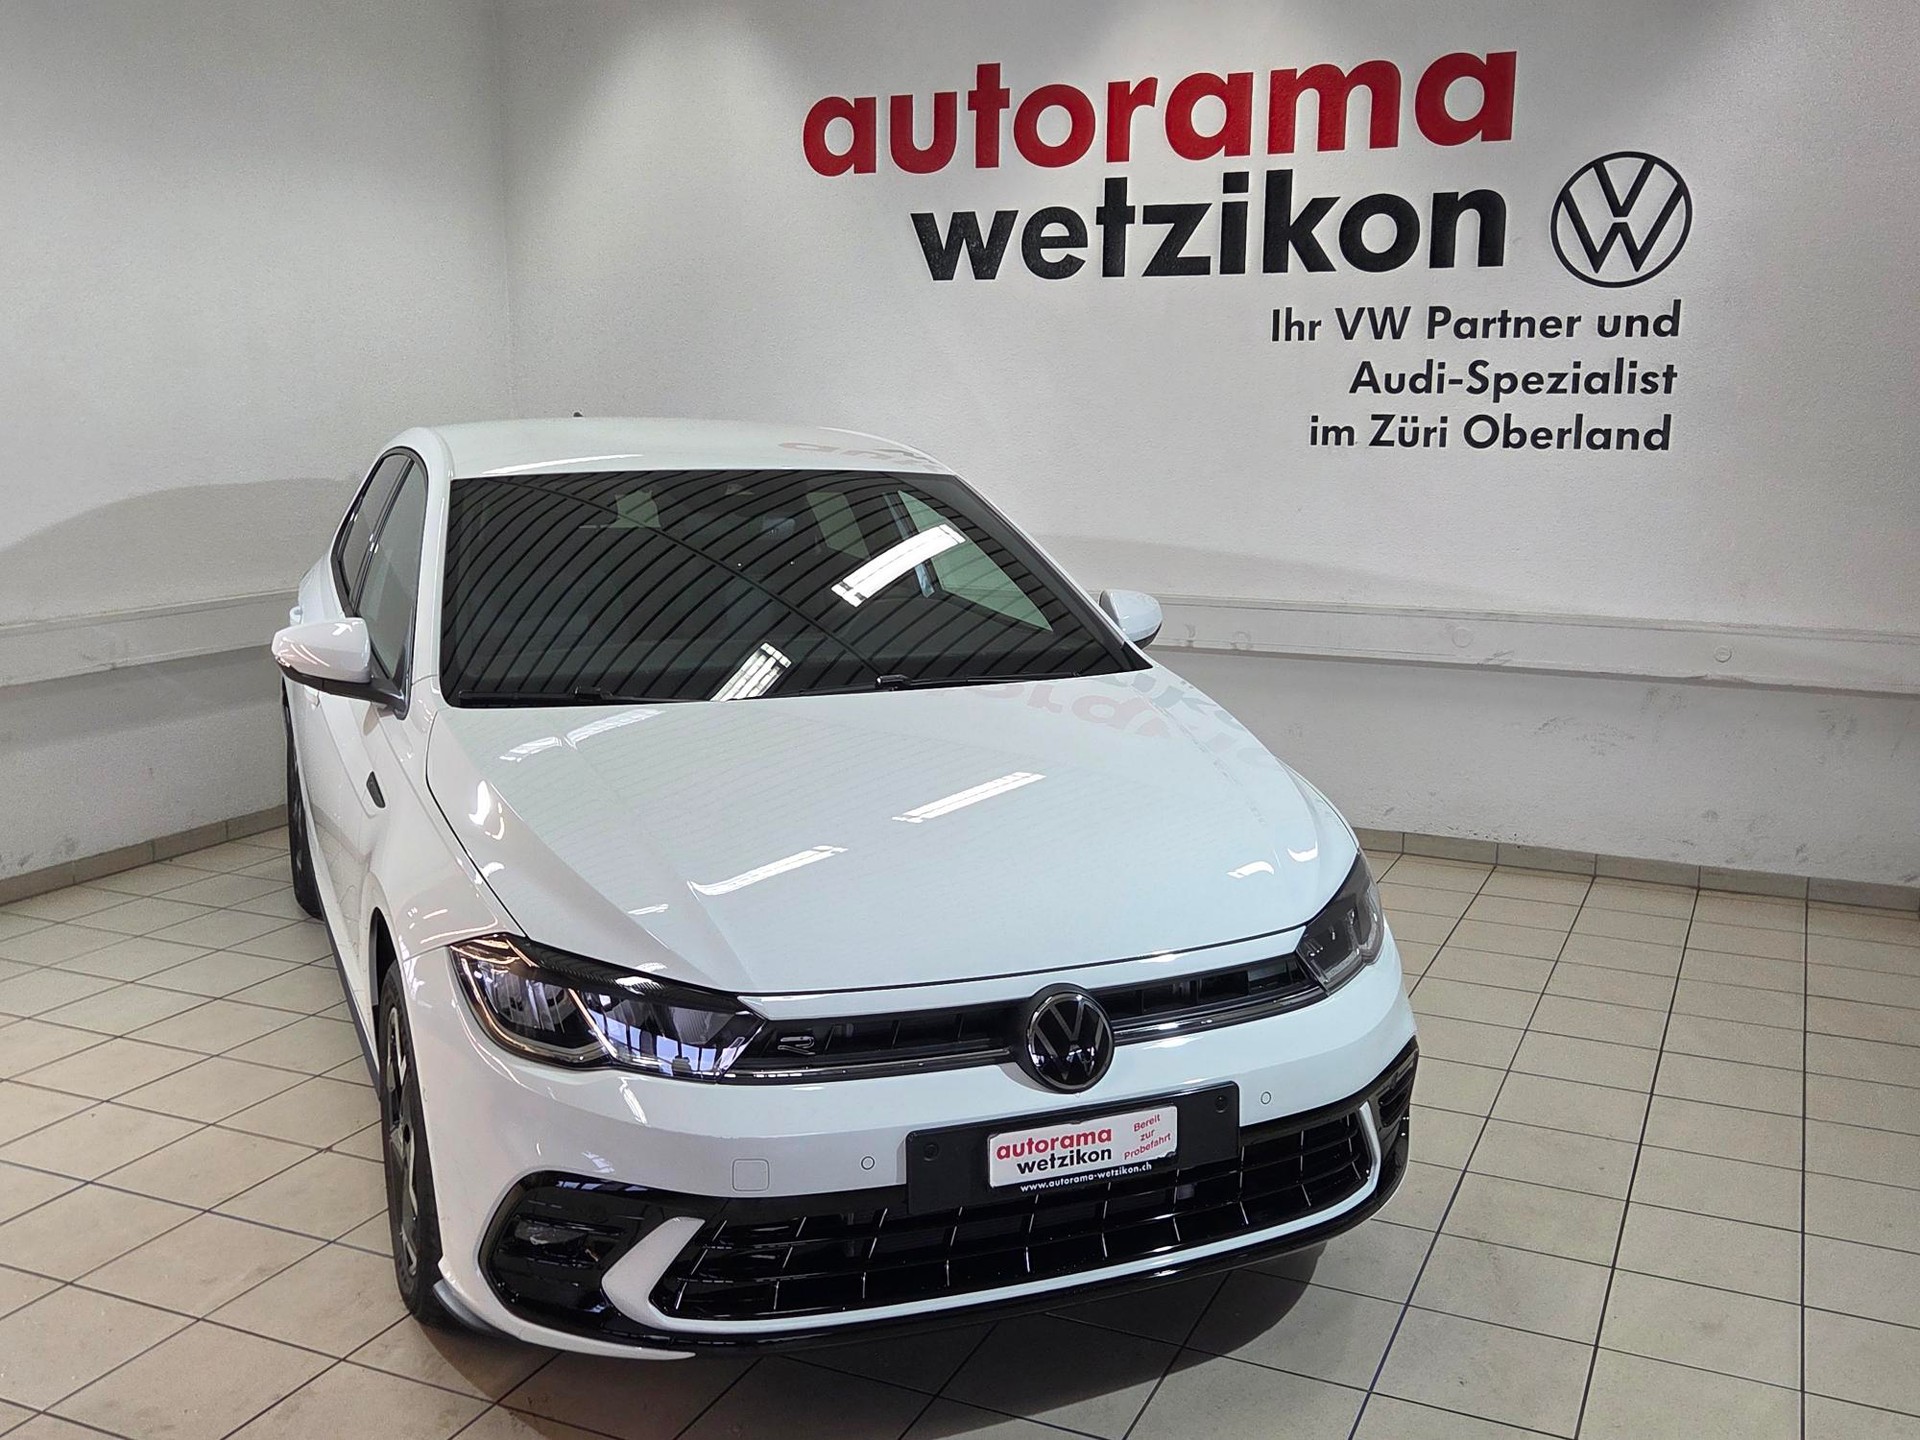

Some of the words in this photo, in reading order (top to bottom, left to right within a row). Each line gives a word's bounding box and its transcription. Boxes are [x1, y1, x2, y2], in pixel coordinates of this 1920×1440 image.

[803, 52, 1516, 177] autorama
[910, 168, 1508, 281] wetzikon
[1271, 306, 1322, 342] Ihr
[1334, 305, 1412, 341] VW
[1427, 304, 1582, 340] Partner
[1597, 298, 1682, 339] und
[1348, 356, 1679, 404] Audi-Spezialist
[1310, 415, 1356, 447] im
[1368, 413, 1449, 448] Züri
[1463, 413, 1672, 451] Oberland
[1133, 1113, 1161, 1132] Bereit
[1140, 1129, 1156, 1142] zur
[996, 1128, 1113, 1160] autorama
[1123, 1132, 1172, 1160] Probefahrt
[1016, 1148, 1112, 1175] wetzikon
[1020, 1161, 1153, 1193] www.autorama-wetzikon.ch
